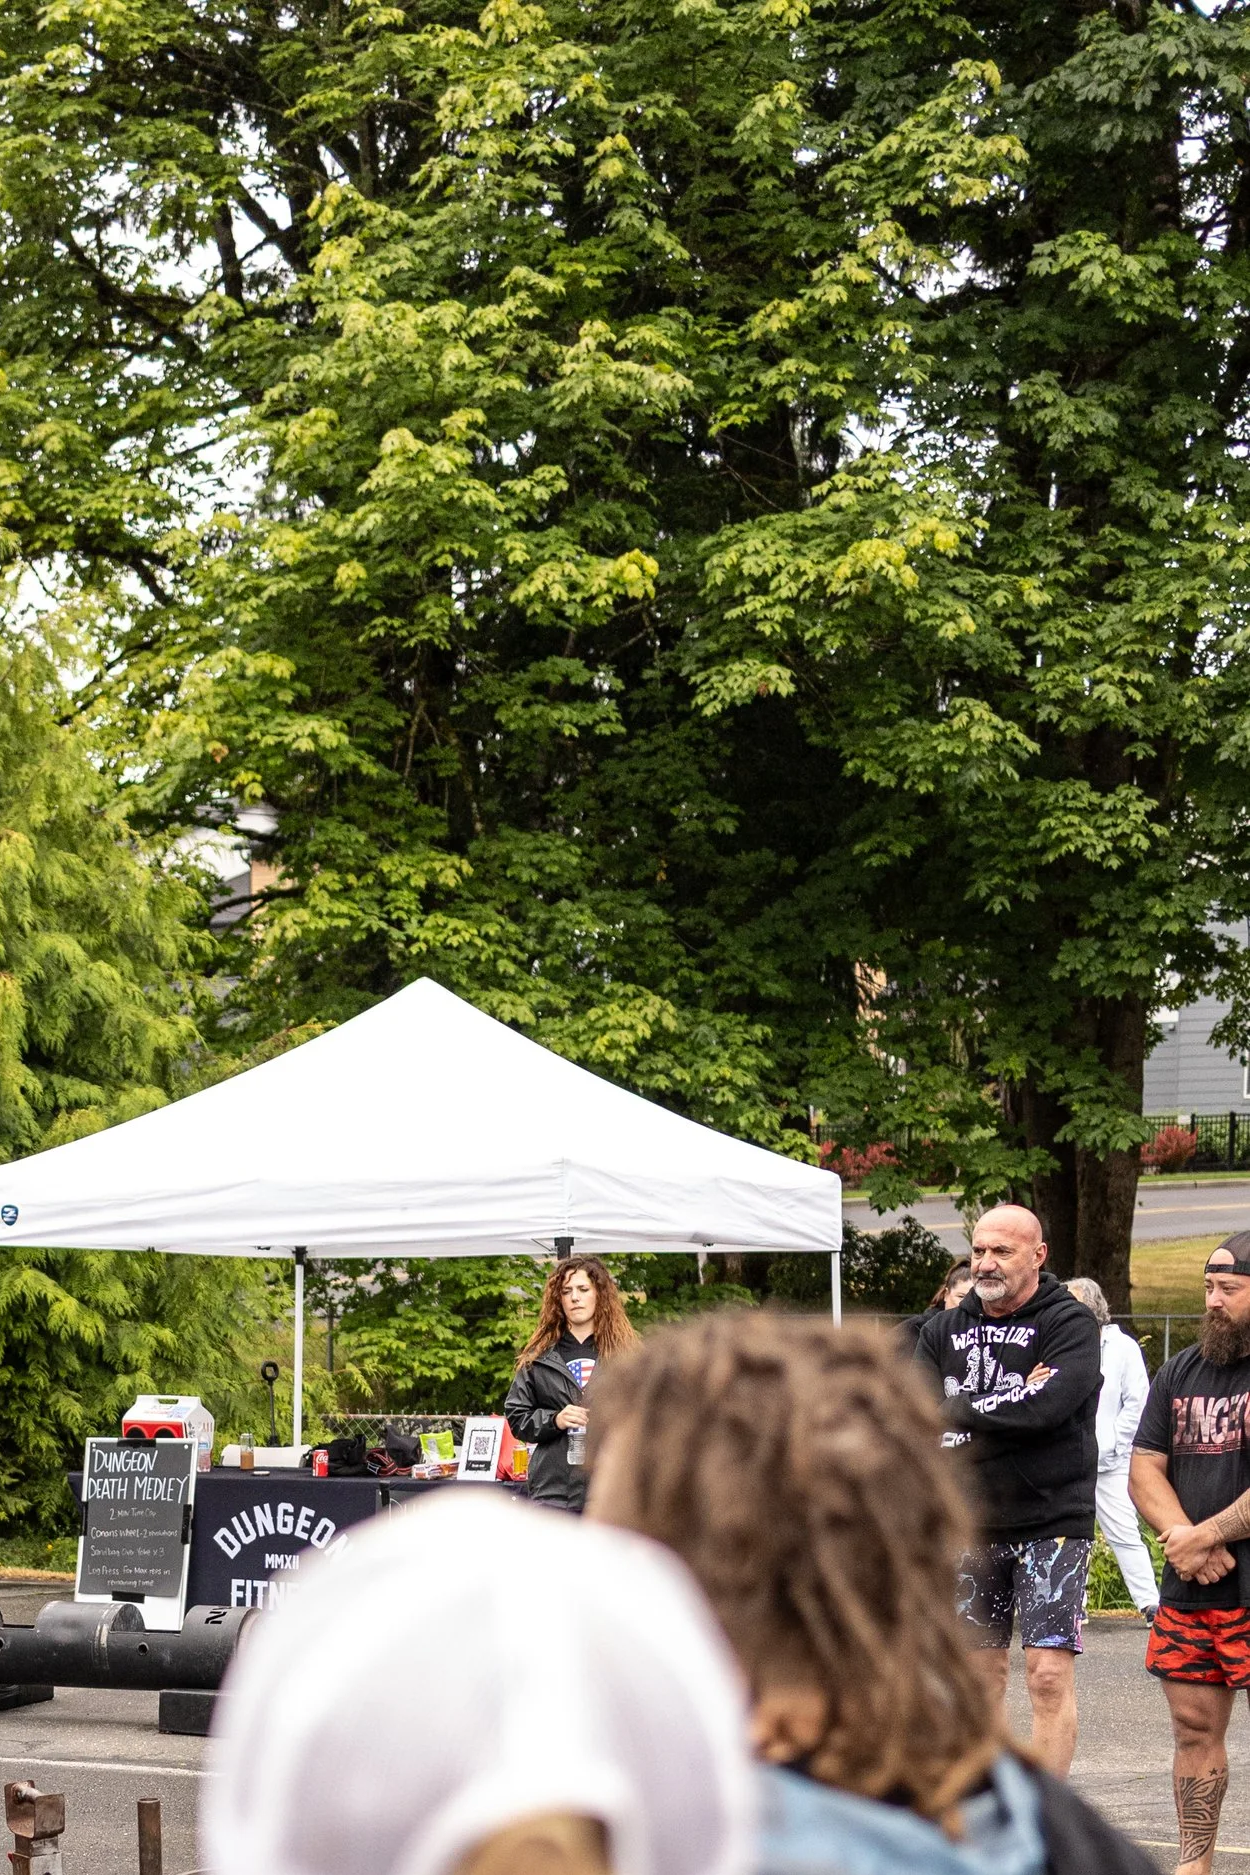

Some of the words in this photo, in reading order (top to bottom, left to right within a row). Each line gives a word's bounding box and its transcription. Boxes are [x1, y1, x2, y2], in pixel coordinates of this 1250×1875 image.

[88, 1477, 128, 1500] DEATH
[109, 1508, 117, 1520] 2
[265, 1553, 300, 1570] MMXII
